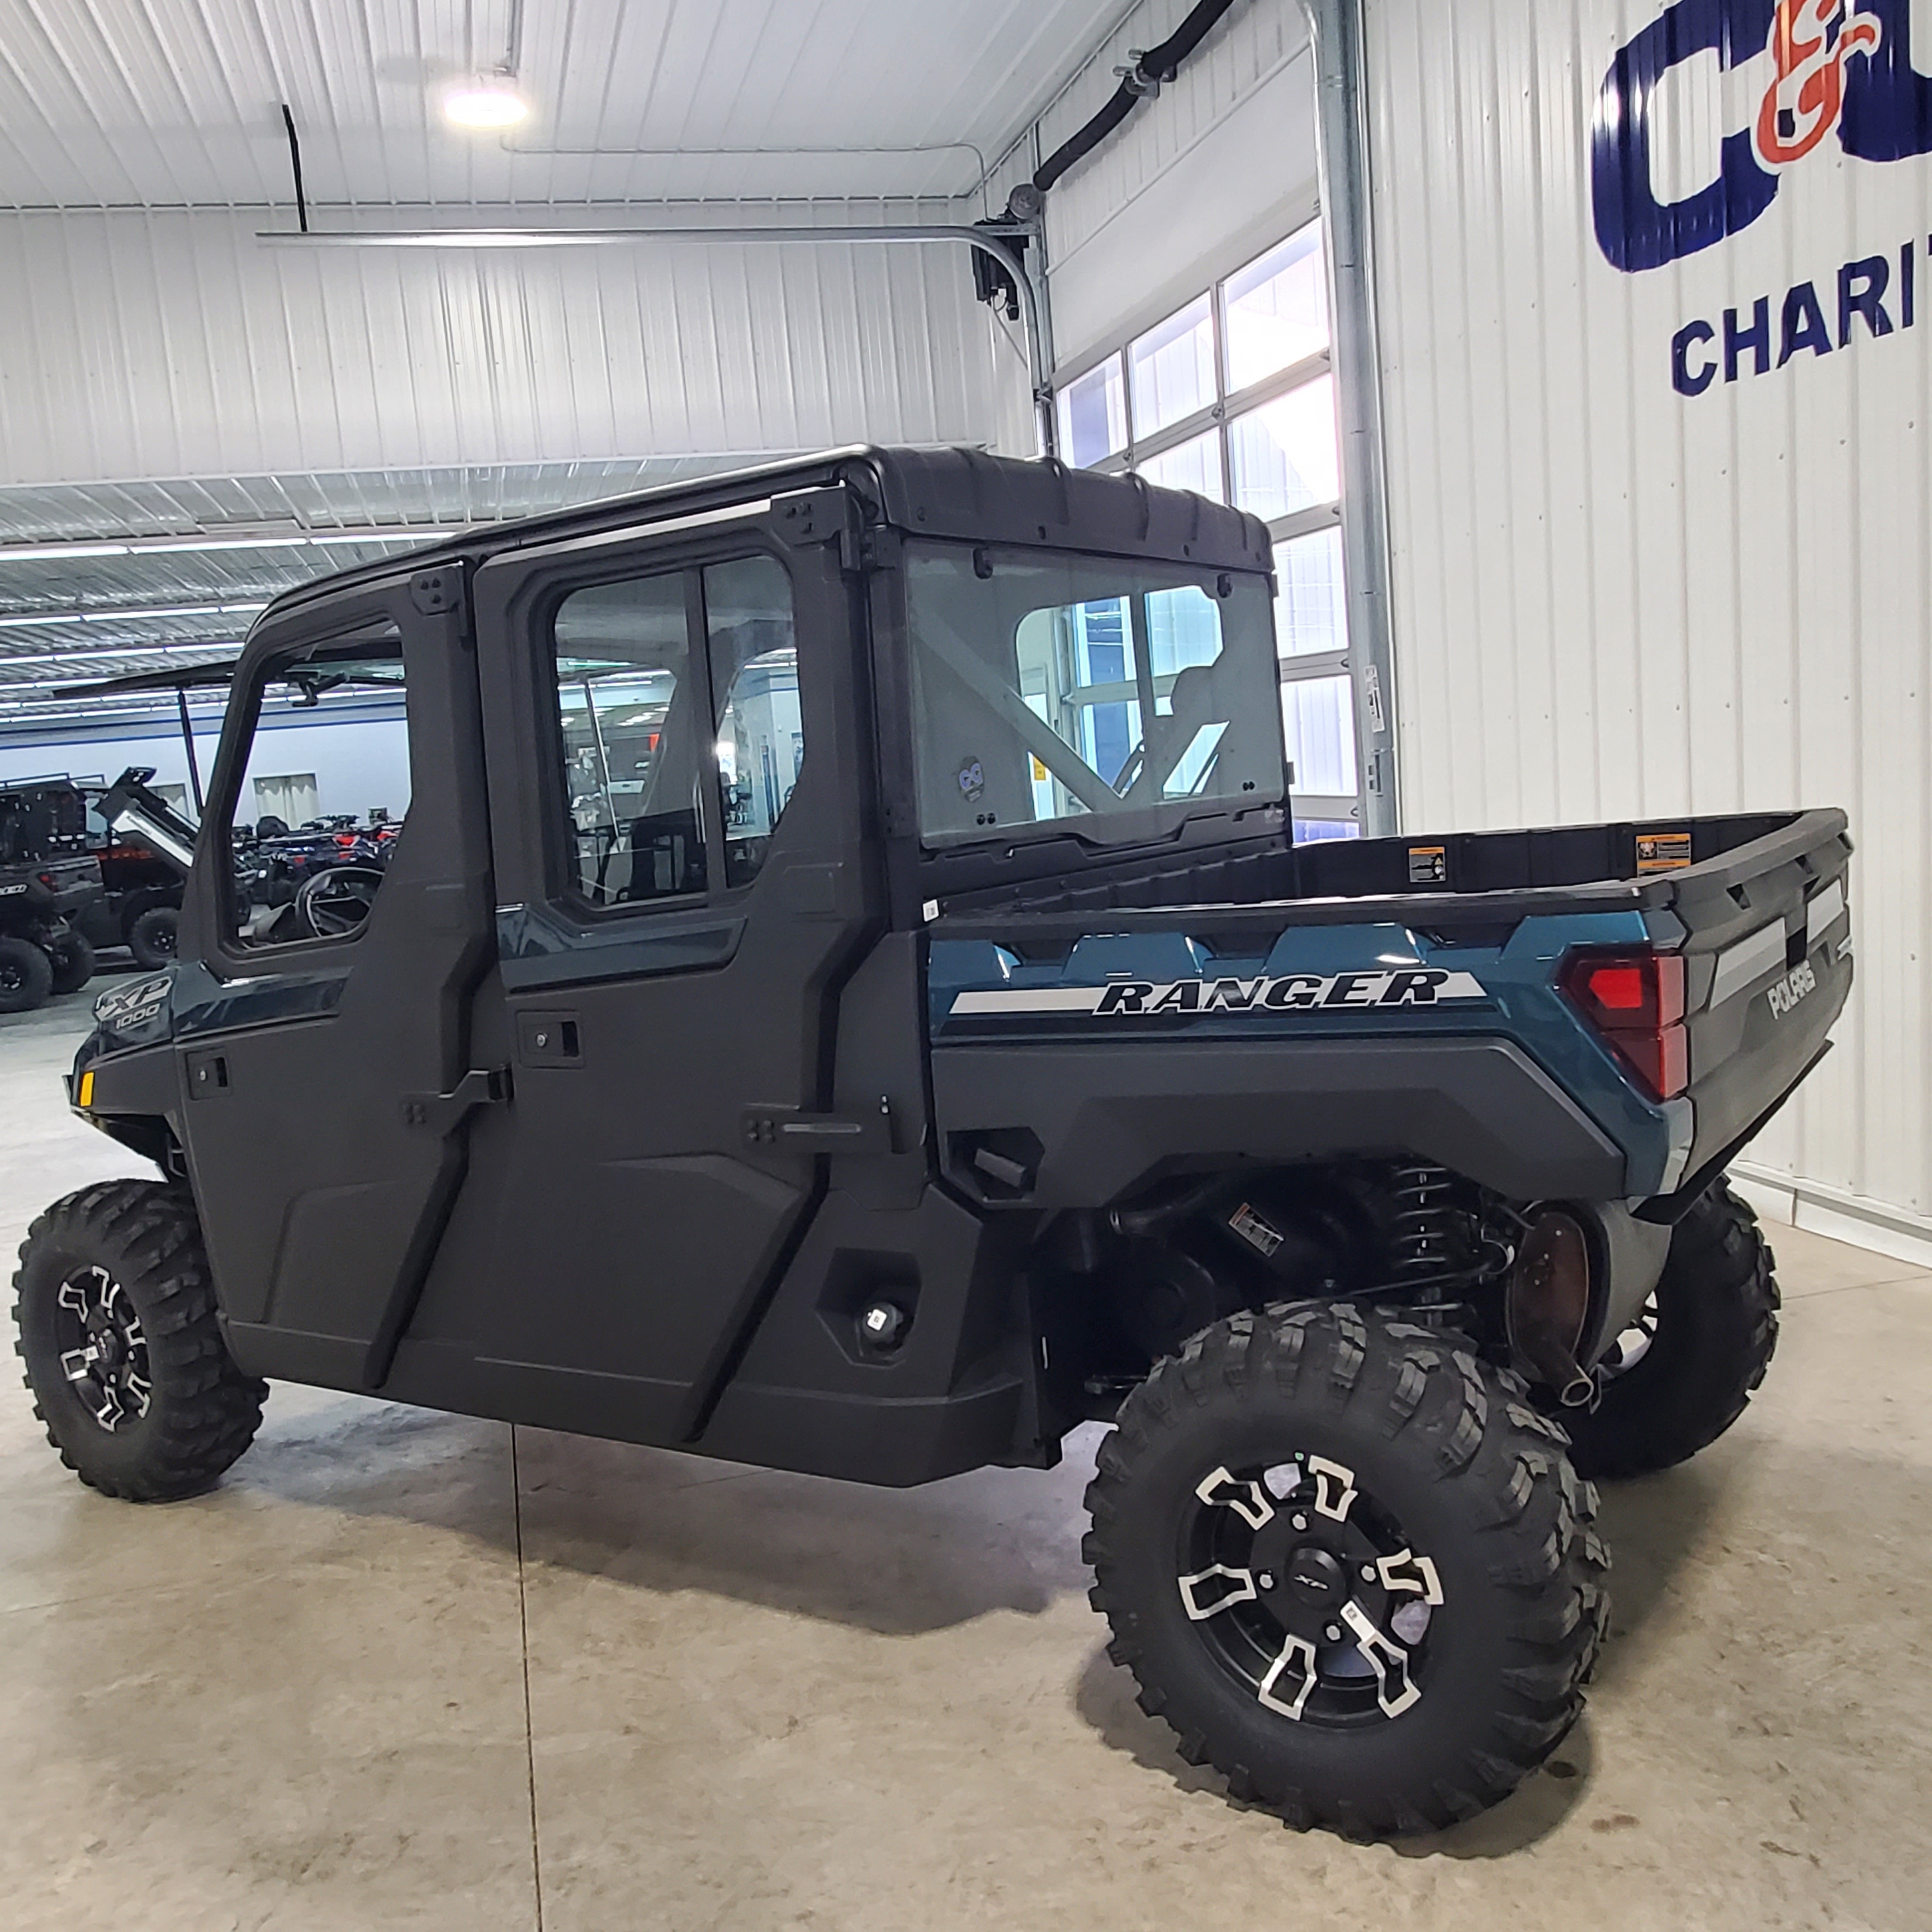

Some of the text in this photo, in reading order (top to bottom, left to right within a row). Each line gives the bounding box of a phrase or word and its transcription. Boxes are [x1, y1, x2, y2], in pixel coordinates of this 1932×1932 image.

[1671, 233, 1932, 397] CHARI
[103, 978, 171, 1019] XP
[1092, 968, 1449, 1015] RANGER
[115, 1002, 161, 1030] 1000
